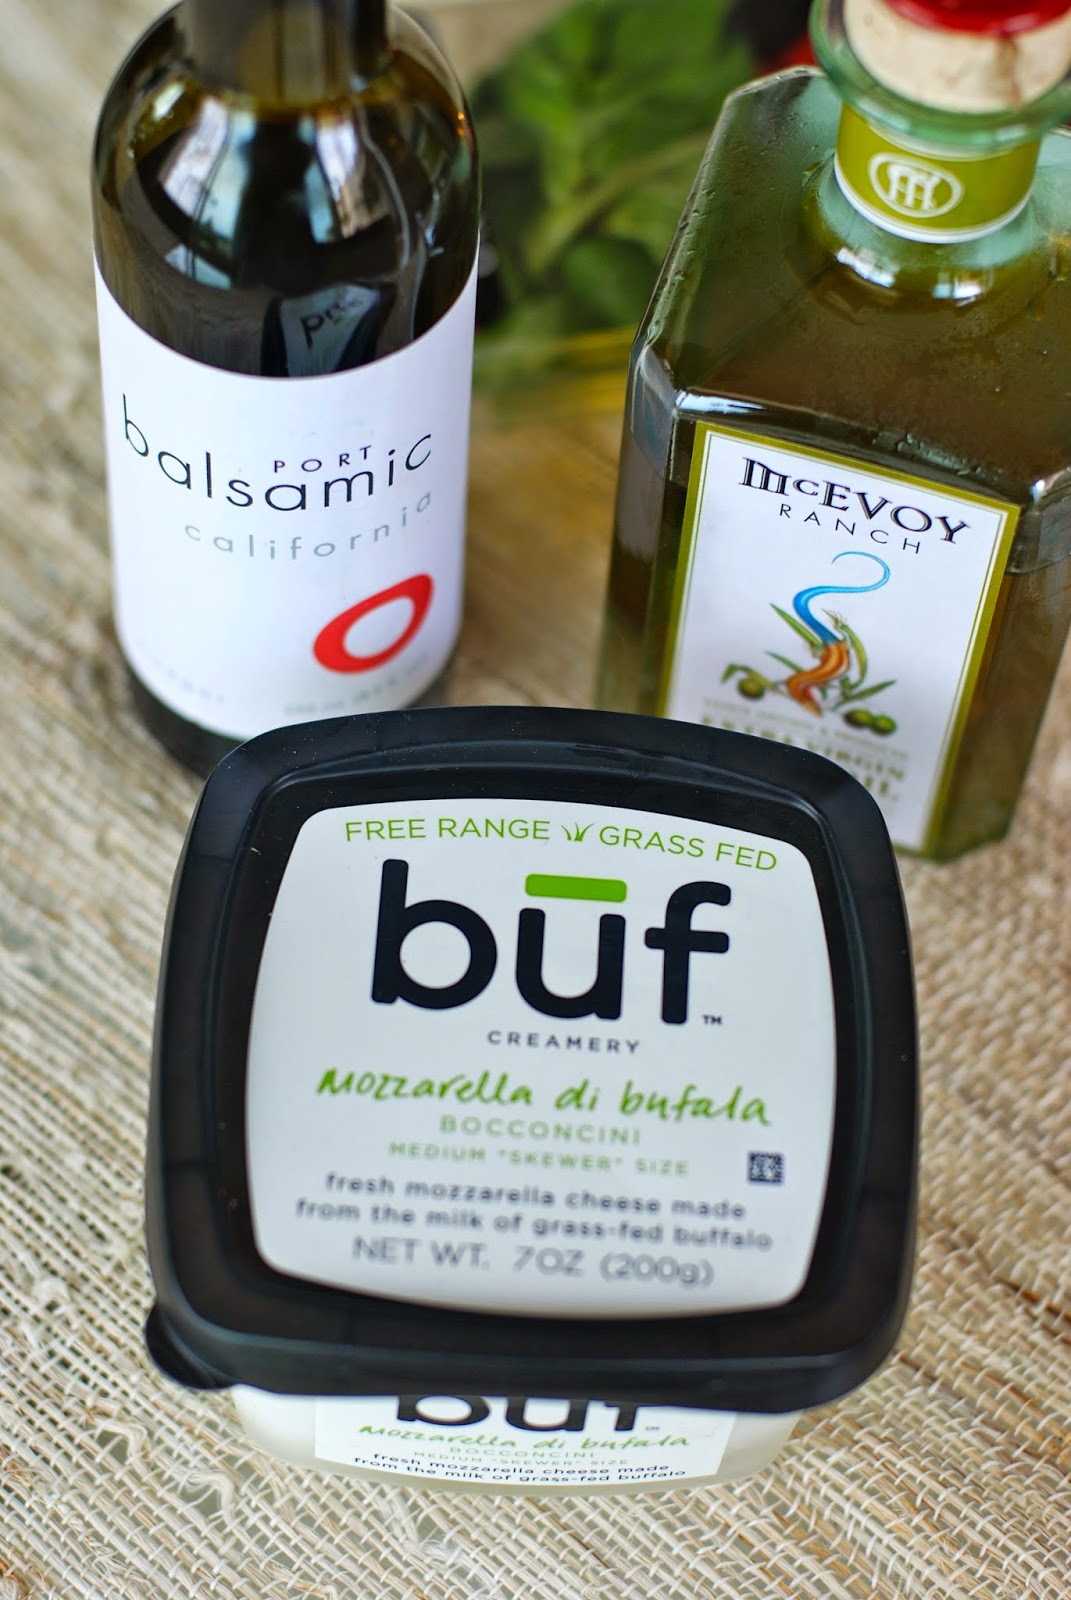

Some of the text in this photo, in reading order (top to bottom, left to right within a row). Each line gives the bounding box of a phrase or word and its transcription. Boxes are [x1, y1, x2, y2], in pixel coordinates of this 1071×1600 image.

[122, 392, 433, 511] balsamic
[274, 445, 372, 474] PORT
[184, 491, 431, 559] california
[779, 503, 920, 554] RANCH
[345, 817, 777, 871] FREE RANGE GRASS FED
[487, 1030, 641, 1055] CREAMERY
[553, 1078, 600, 1113] di
[619, 1078, 772, 1127] bufala
[439, 1113, 642, 1146] BOCCONCINI
[389, 1141, 690, 1177] MEDIUM "SKEWER" SIZE
[324, 1171, 746, 1220] fresh mozzarella cheese made
[296, 1197, 772, 1252] from the milk of grass-fed buffalo
[351, 1236, 419, 1265] NET
[429, 1240, 491, 1271] WT.
[599, 1250, 714, 1288] (200g)
[414, 1451, 482, 1462] MEDIUM
[591, 1458, 628, 1466] SIZE
[449, 1446, 595, 1459] BOCCONCINI
[533, 1436, 566, 1450] di
[581, 1432, 690, 1450] bufala
[354, 1457, 686, 1484] from the milk of grass-fed buffalo
[373, 1453, 669, 1475] fresh mozzarella cheese made
